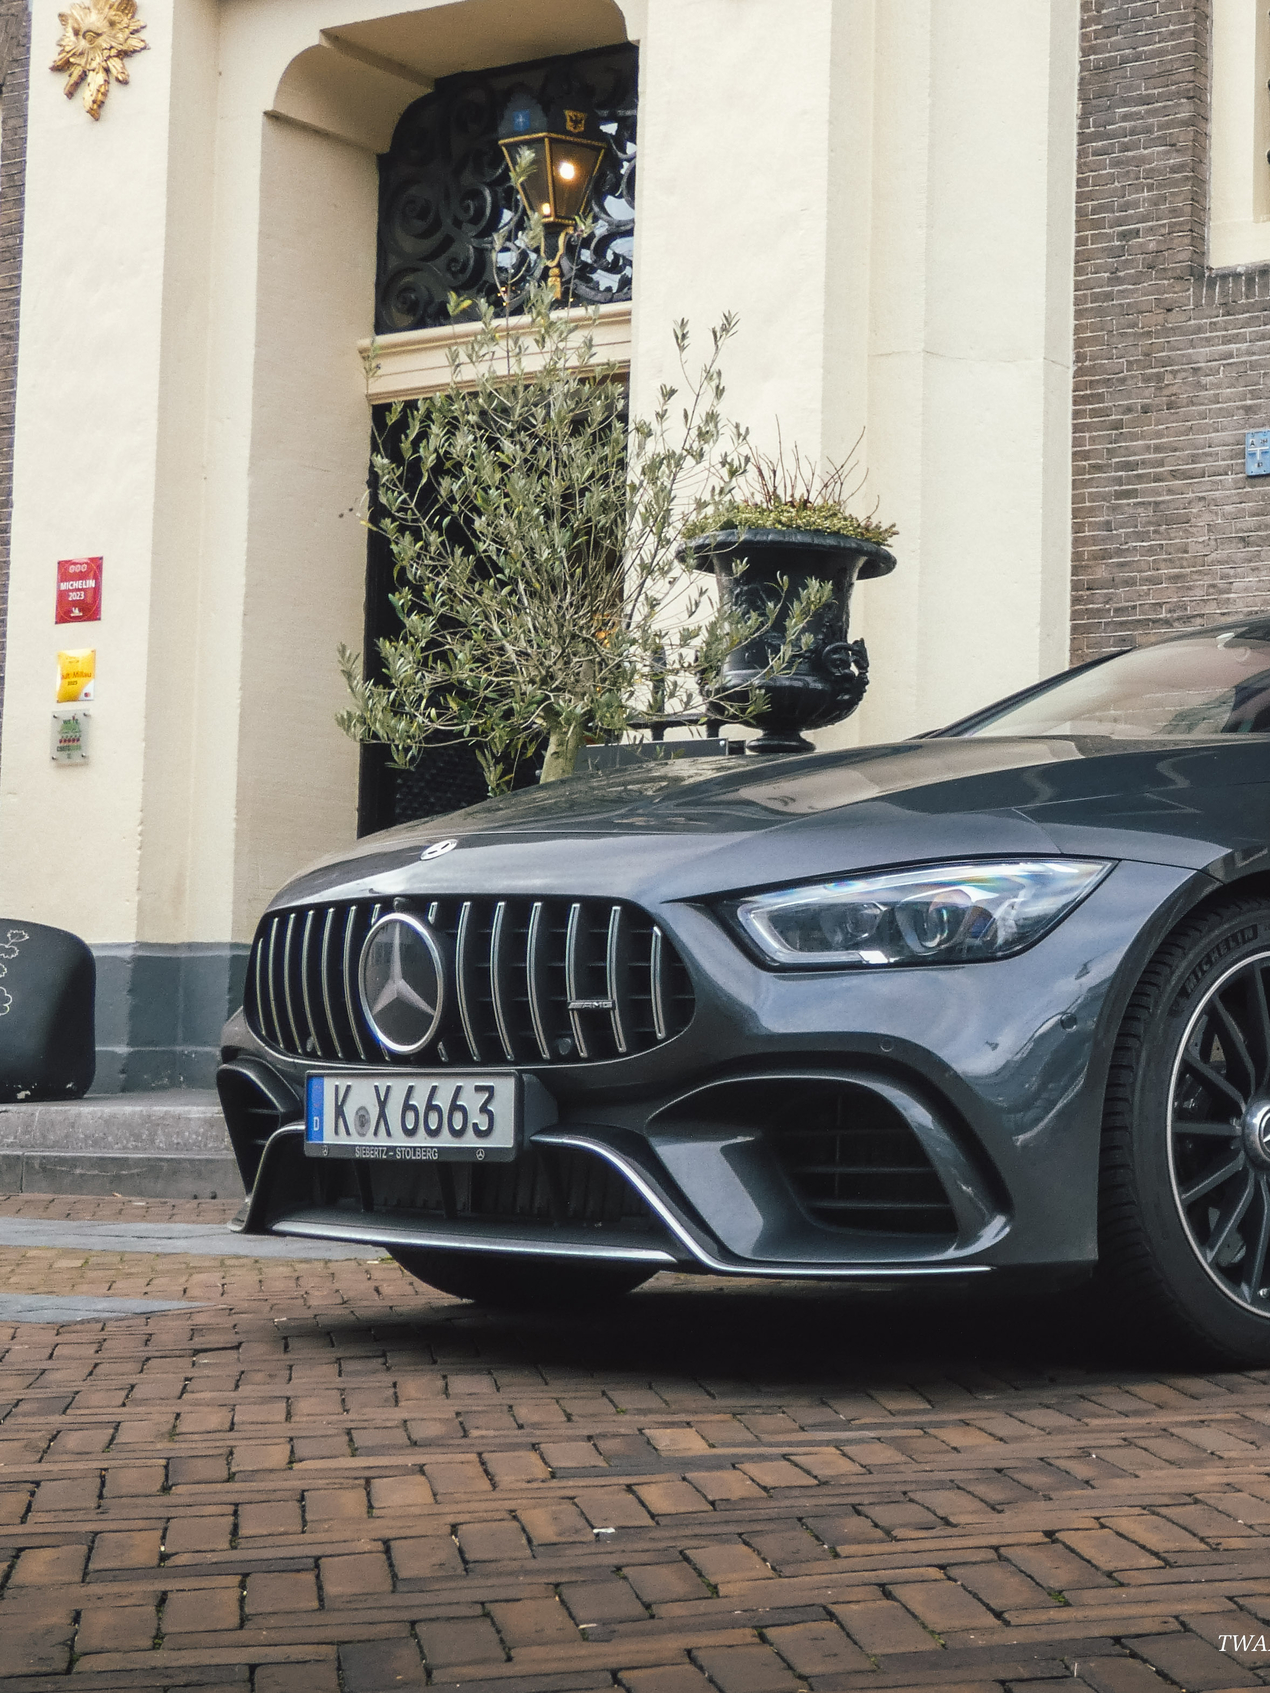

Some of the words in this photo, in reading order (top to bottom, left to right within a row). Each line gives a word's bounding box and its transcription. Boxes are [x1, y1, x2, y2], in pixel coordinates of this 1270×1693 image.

[60, 579, 96, 591] MICHELIN
[68, 591, 85, 601] 2023
[1184, 925, 1257, 994] MICHELIN
[582, 1001, 613, 1009] AMG
[312, 1116, 320, 1131] D
[355, 1146, 387, 1160] SIEBERTZ
[396, 1147, 439, 1161] STOLBERG
